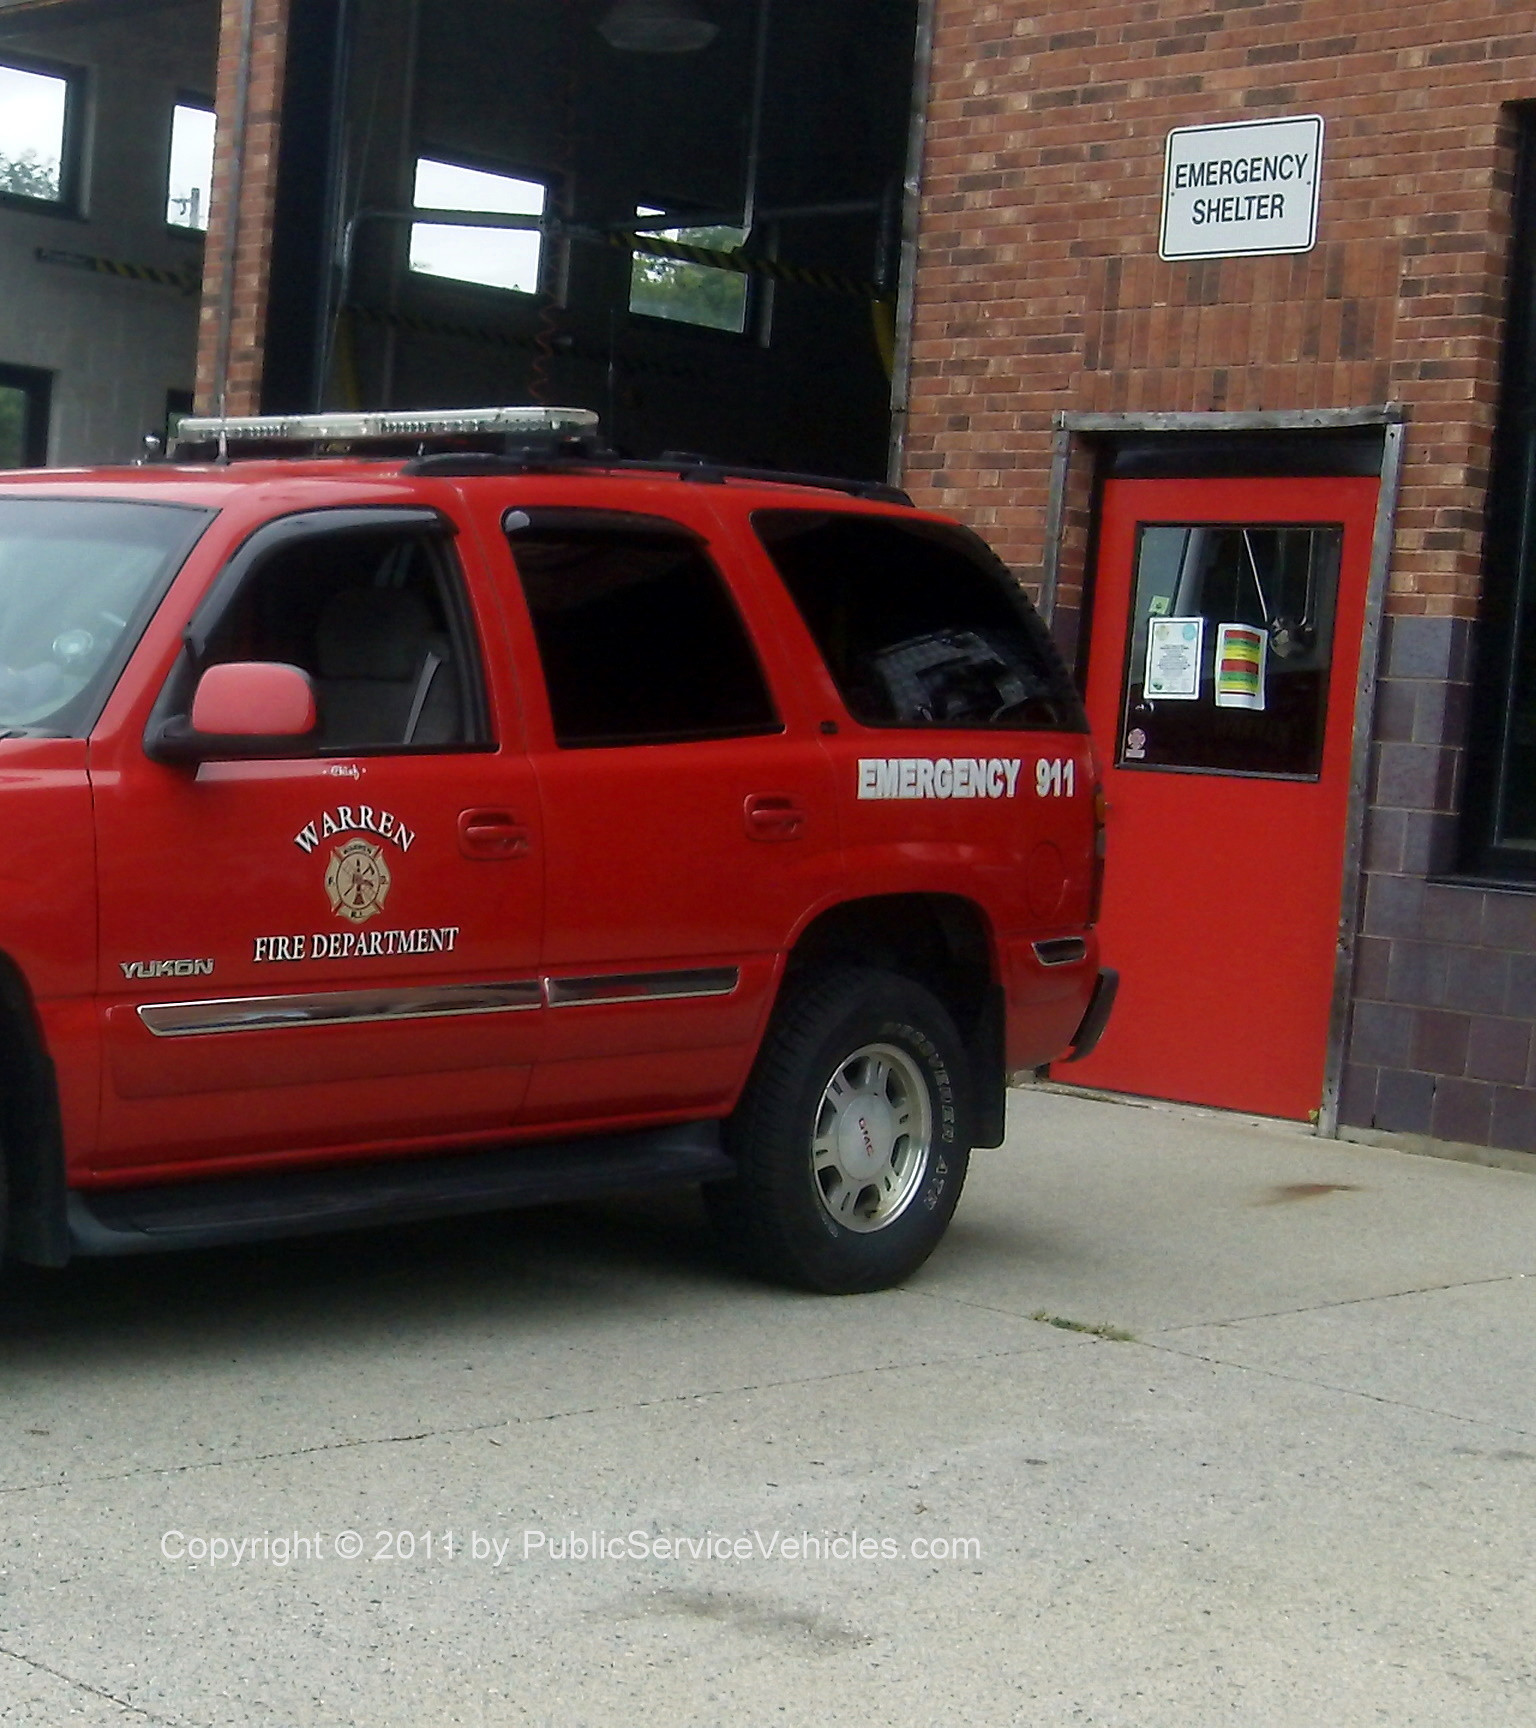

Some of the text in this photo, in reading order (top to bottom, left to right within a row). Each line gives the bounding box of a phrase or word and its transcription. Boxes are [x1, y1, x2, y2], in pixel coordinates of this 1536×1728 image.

[1175, 153, 1308, 189] EMERGENCY
[1192, 193, 1284, 225] SHELTER
[857, 758, 1075, 800] EMERGENCY 911
[294, 805, 416, 854] WARREN
[253, 926, 460, 963] FIRE DEPARTMENT
[119, 958, 215, 980] YUKON
